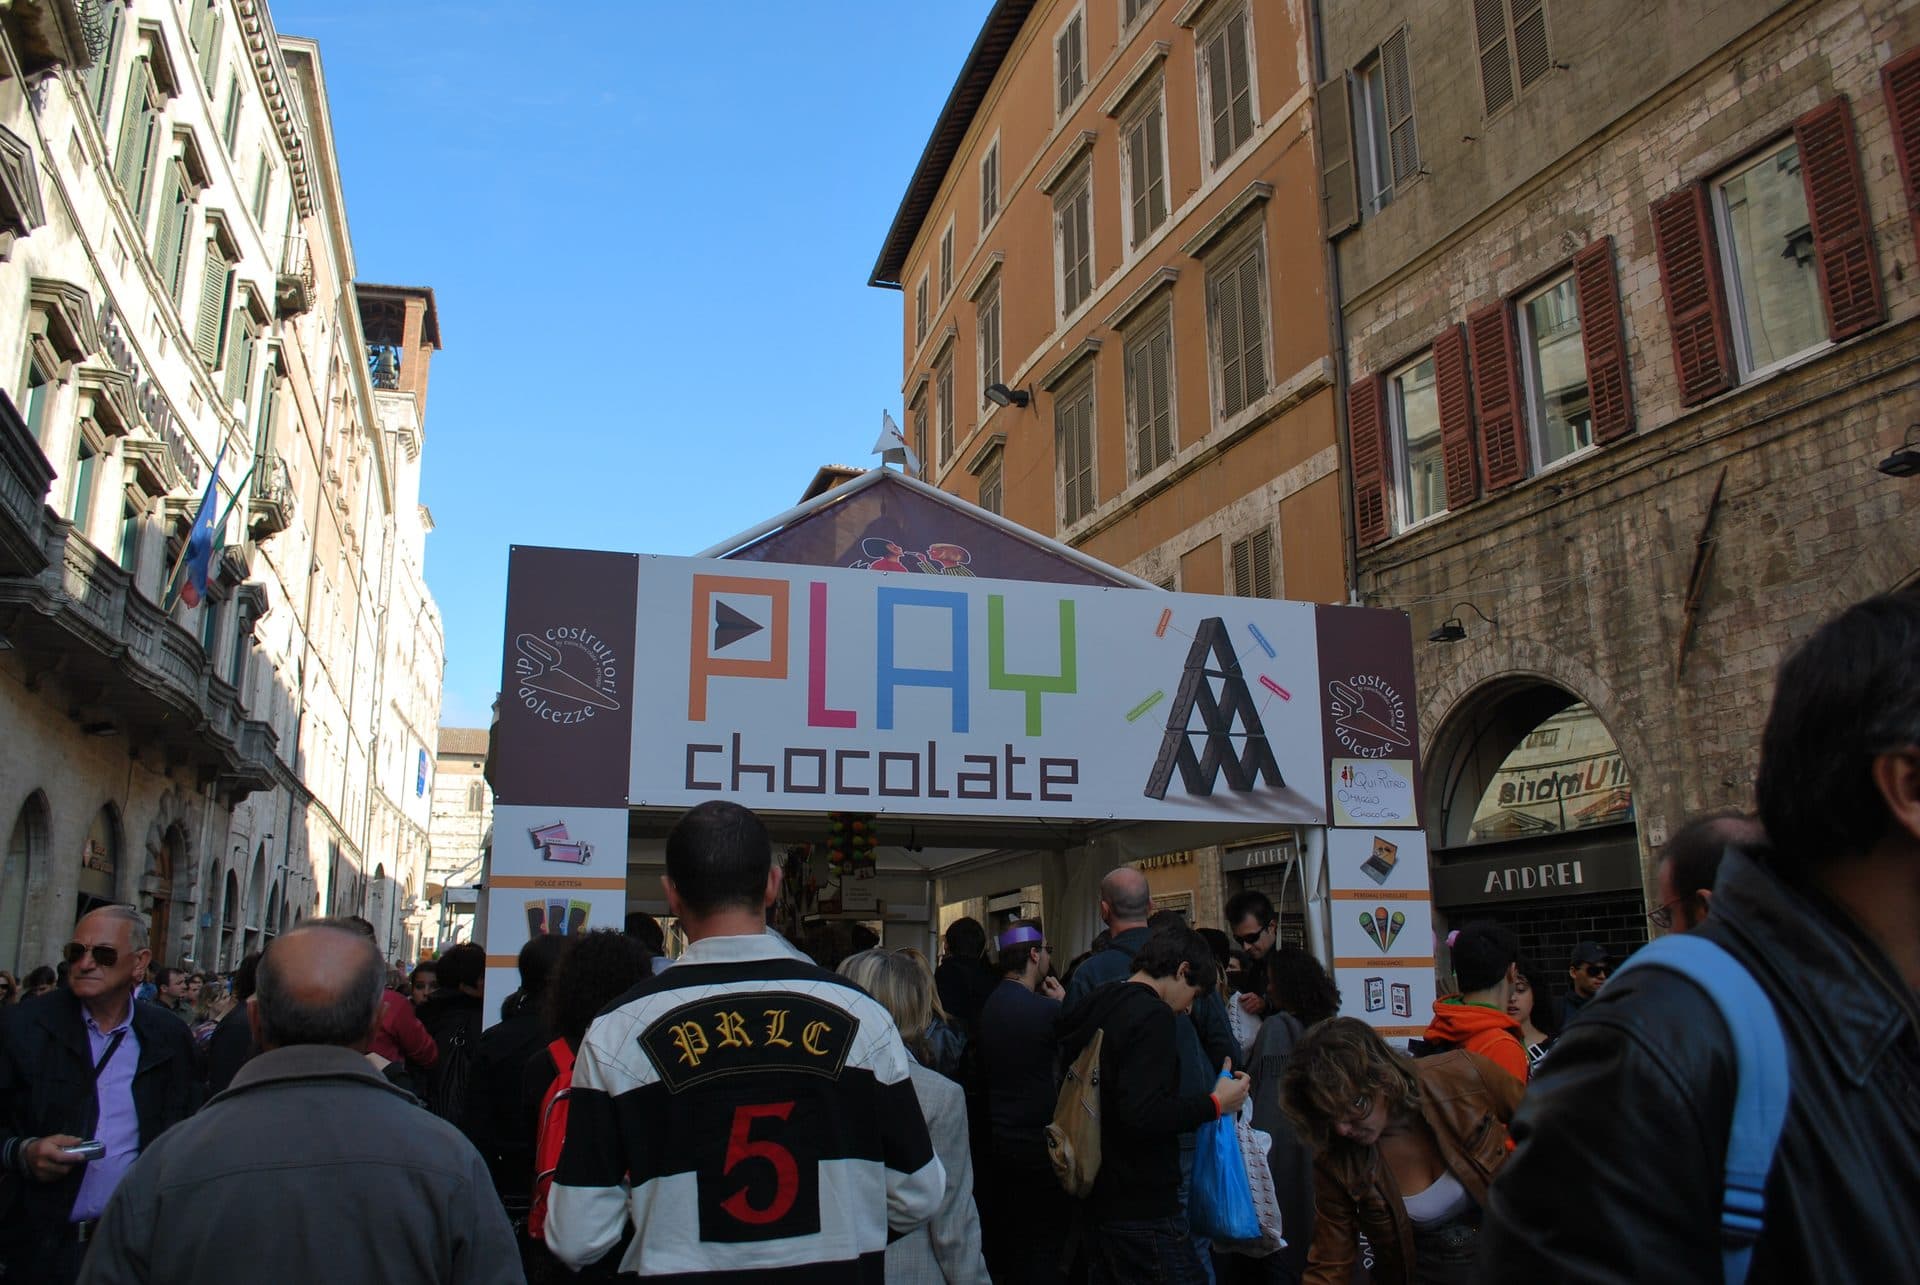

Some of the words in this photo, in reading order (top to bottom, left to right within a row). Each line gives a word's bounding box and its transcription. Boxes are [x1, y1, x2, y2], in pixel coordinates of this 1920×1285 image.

[515, 658, 534, 676] di
[546, 626, 618, 694] costruttori
[688, 573, 1078, 737] PLAY
[518, 686, 595, 724] dolcezze
[1350, 674, 1407, 733] costruttori
[685, 732, 1080, 803] chocolate
[1335, 726, 1393, 759] dolcezze
[1483, 861, 1583, 893] ANDREI
[720, 1101, 799, 1224] 5
